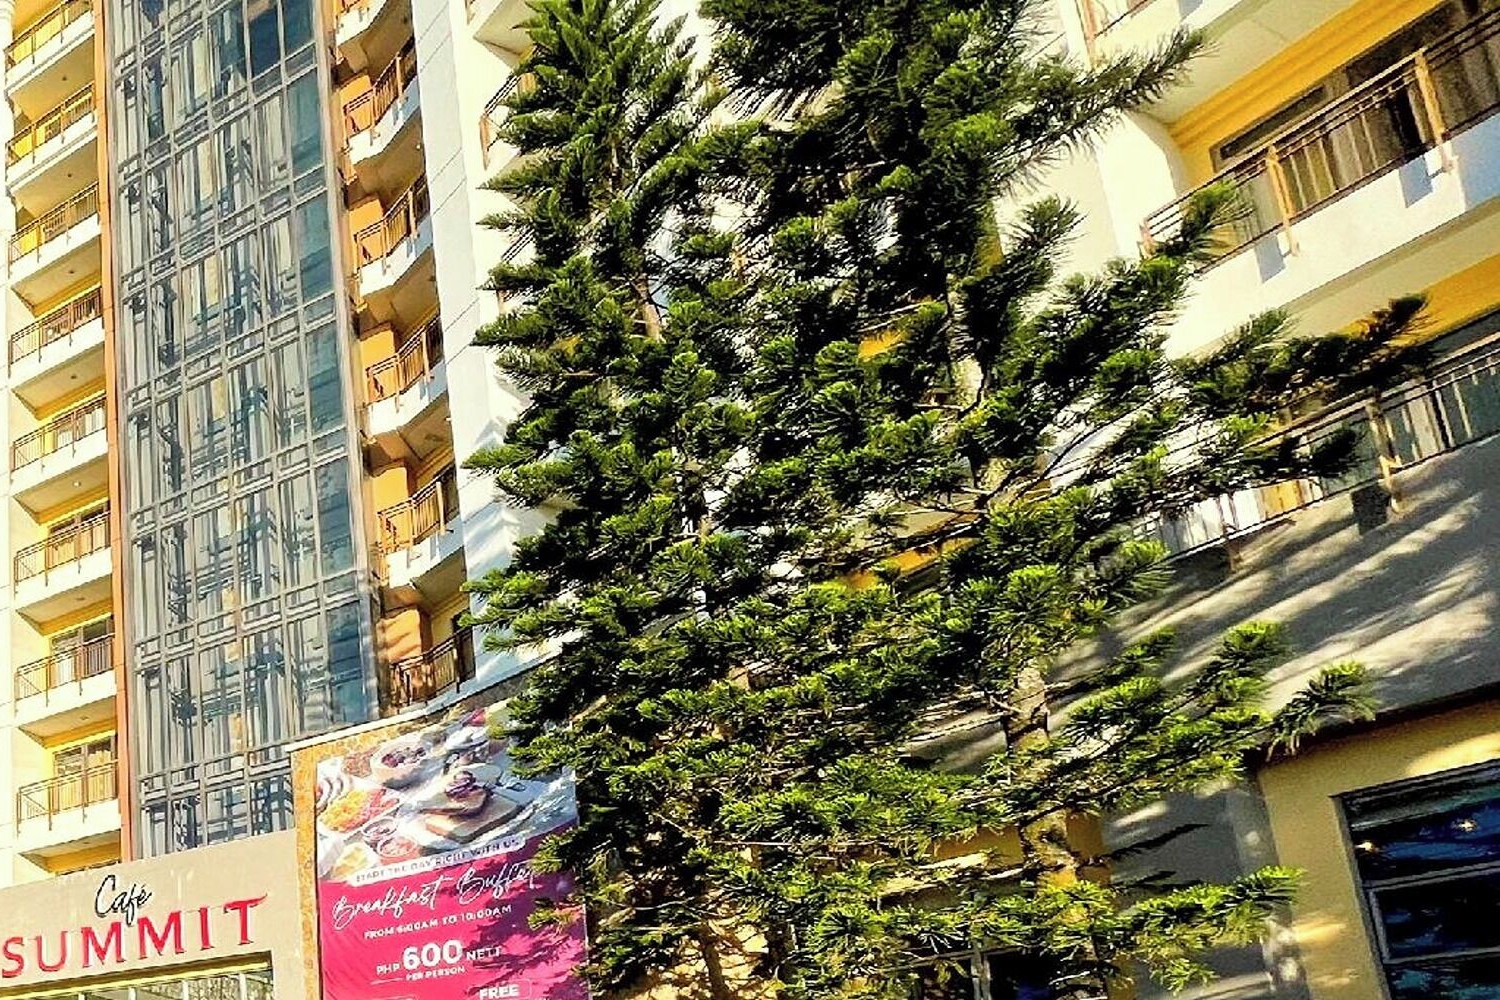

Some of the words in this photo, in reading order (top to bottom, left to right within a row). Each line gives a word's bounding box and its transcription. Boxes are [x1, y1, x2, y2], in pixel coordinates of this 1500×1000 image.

[434, 852, 465, 866] RIGHT
[470, 844, 501, 857] WITH
[504, 838, 520, 848] US
[94, 874, 153, 927] Café
[331, 875, 453, 930] Breakfast
[1, 892, 269, 978] SUMMIT
[364, 926, 396, 939] FROM
[441, 915, 458, 926] TO
[376, 962, 401, 975] PHP
[402, 939, 464, 970] 600
[466, 945, 503, 960] NETT
[405, 972, 424, 981] PER
[424, 966, 466, 979] PERSON
[479, 983, 519, 1000] FREE
